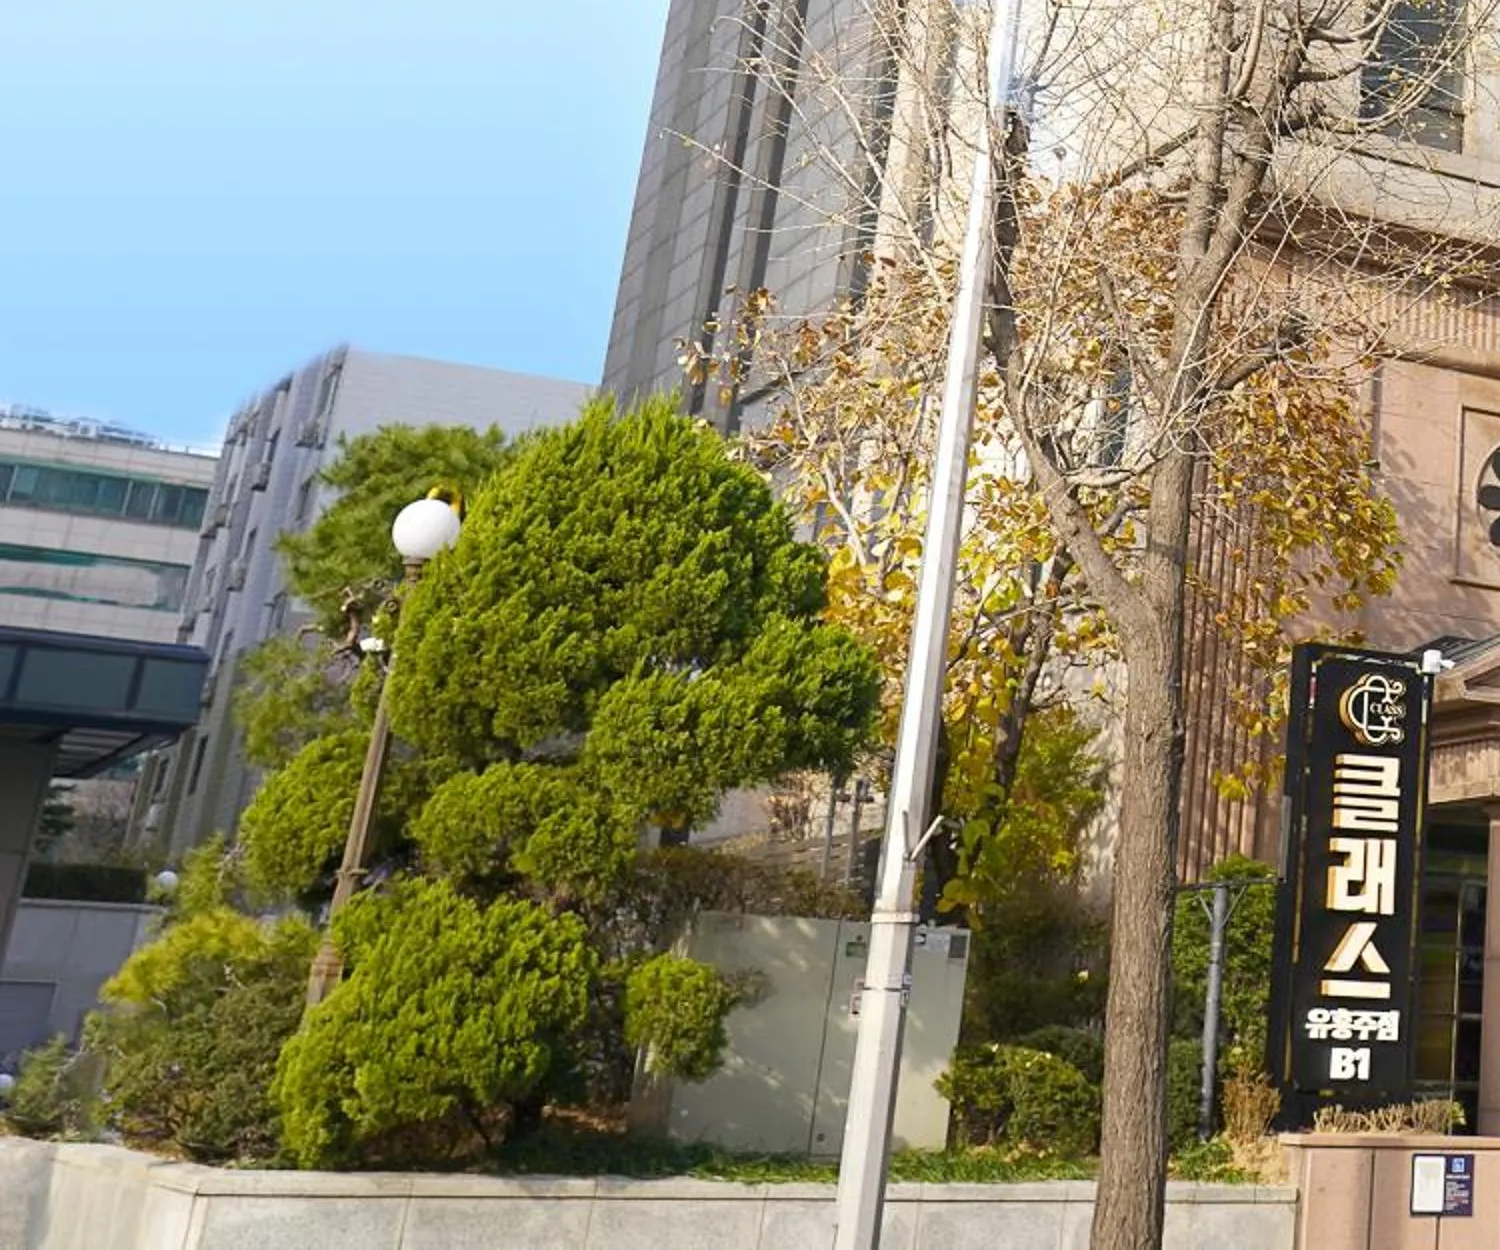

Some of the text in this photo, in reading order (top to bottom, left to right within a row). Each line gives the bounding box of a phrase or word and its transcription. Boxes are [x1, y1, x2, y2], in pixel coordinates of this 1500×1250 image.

[1320, 753, 1401, 998] 클래스
[1305, 1007, 1400, 1041] 유흥주점
[1329, 1047, 1371, 1080] B1
